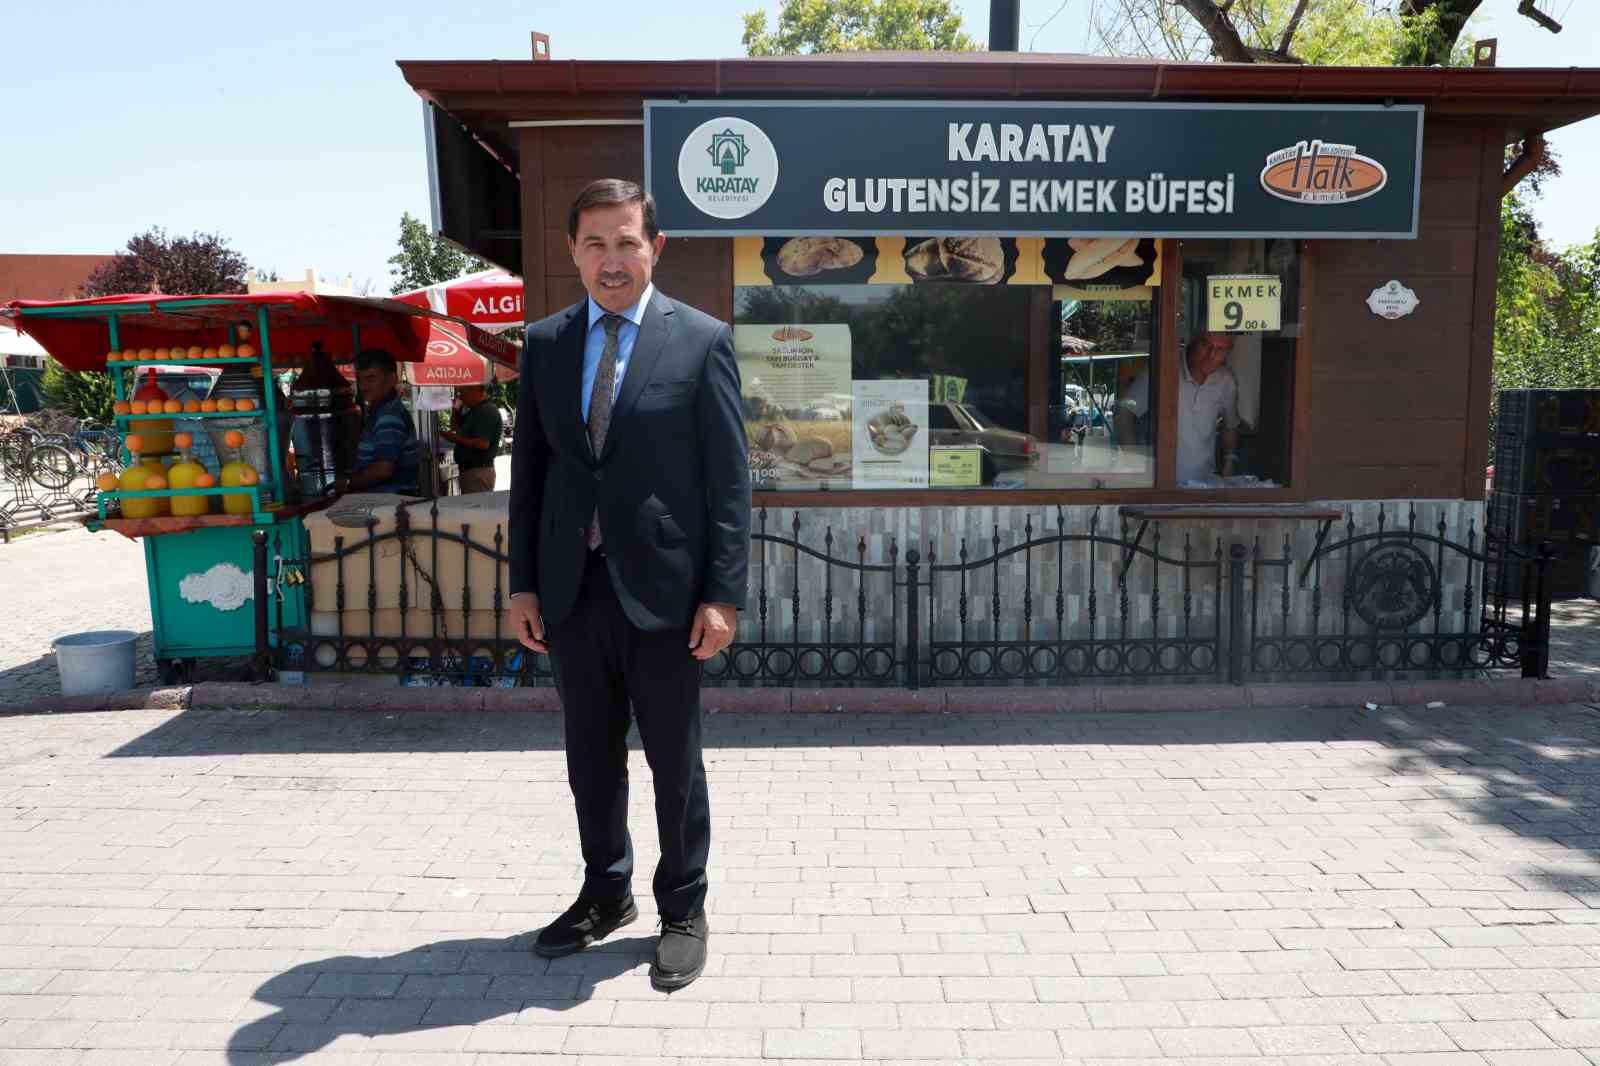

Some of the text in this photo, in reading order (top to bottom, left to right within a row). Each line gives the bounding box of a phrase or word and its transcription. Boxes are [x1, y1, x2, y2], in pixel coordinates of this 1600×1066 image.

[948, 123, 1115, 163] KARATAY
[1291, 142, 1353, 189] Halk
[696, 177, 759, 193] KARATAY
[823, 172, 1235, 214] GLUTENSİZ EKMEK BÜFESİ
[472, 295, 525, 315] ALGİ
[1212, 285, 1277, 298] EKMEK
[1223, 301, 1243, 329] 9
